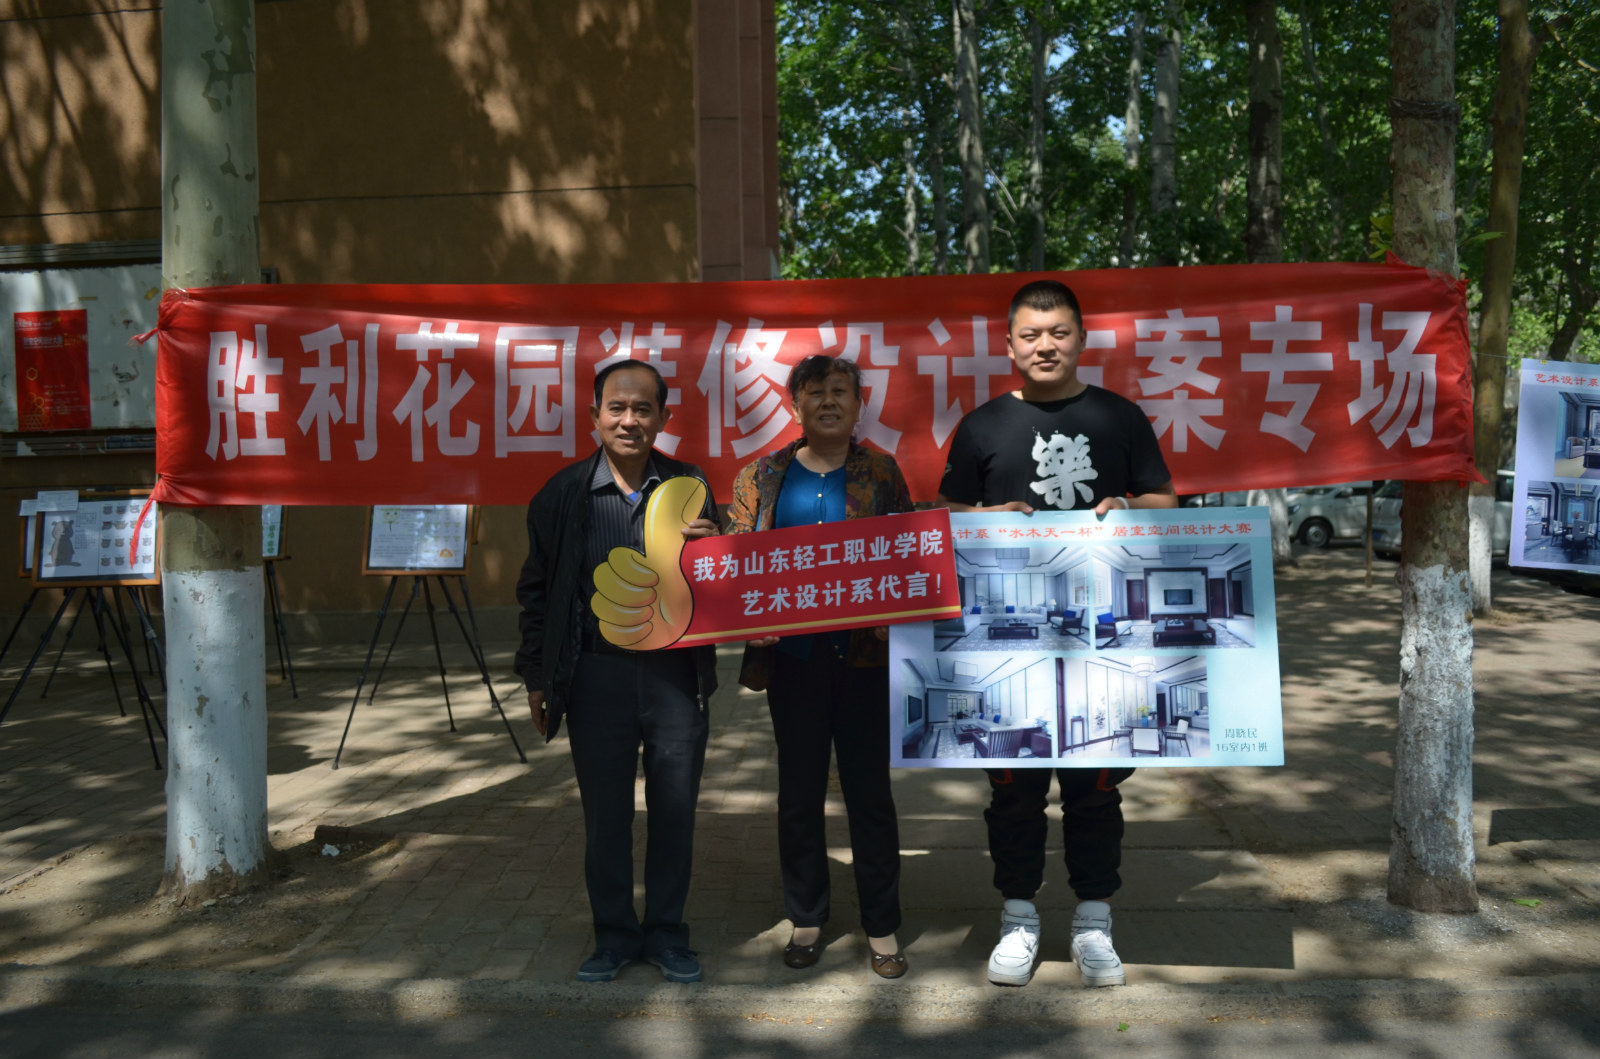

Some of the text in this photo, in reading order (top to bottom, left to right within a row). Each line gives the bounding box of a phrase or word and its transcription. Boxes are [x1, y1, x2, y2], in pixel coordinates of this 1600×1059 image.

[205, 303, 1437, 462] 胜利花园装修设计案专场
[1535, 373, 1599, 387] 艺术设计系
[1029, 431, 1098, 510] 樂
[692, 528, 944, 582] 我为山东轻工职业学院
[952, 522, 1253, 540] 计系“水木天一杯”居室空间设计大赛
